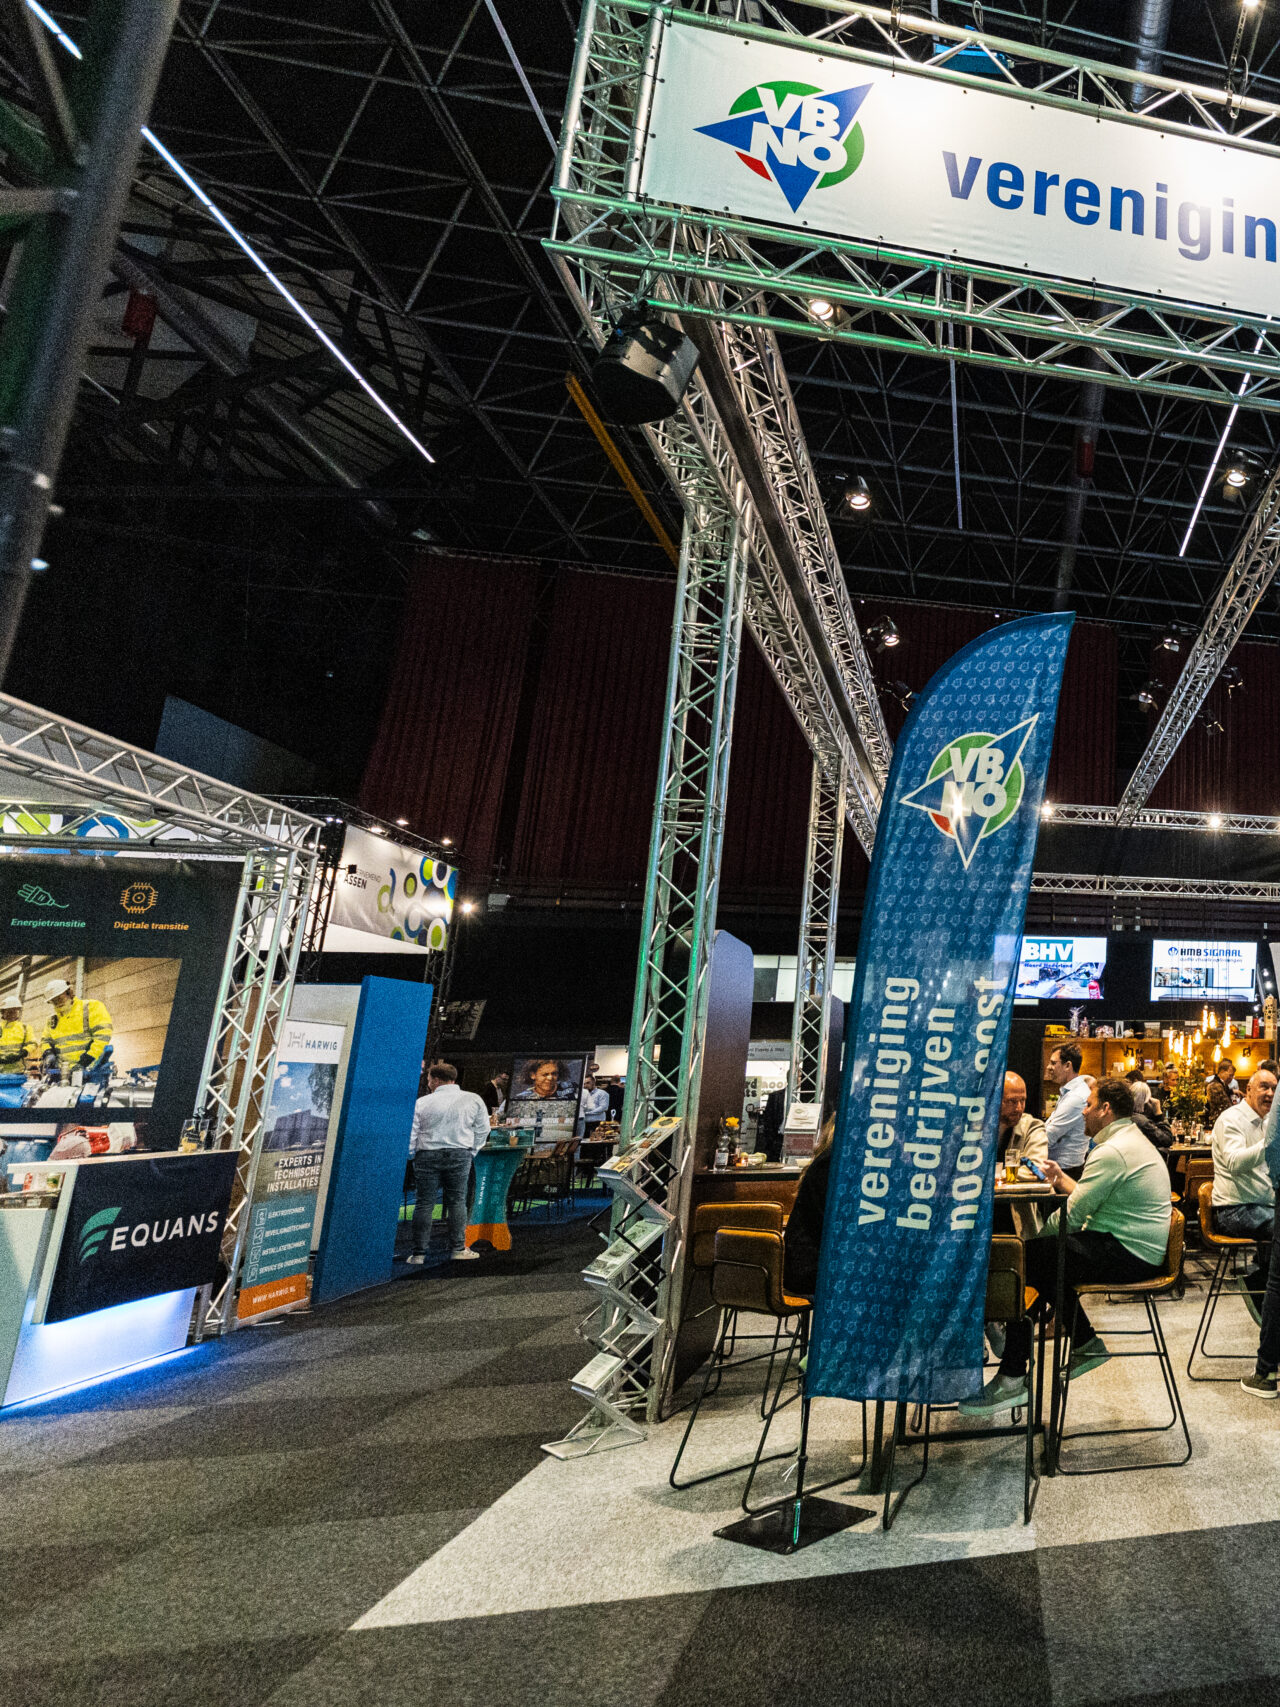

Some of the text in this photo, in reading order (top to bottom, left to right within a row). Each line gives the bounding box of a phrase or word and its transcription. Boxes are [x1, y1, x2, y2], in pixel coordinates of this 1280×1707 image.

[755, 86, 841, 138] VB
[749, 121, 848, 173] NO
[949, 747, 1005, 783] VB
[343, 874, 368, 890] ASSEN
[10, 918, 86, 929] Energietransitie
[113, 921, 189, 932] Digitale transitie
[1022, 942, 1073, 961] BHV
[1180, 948, 1202, 957] HMB
[305, 1039, 338, 1051] HARWIG
[857, 976, 921, 1226] vereniging
[895, 1007, 957, 1231] bedrijven
[277, 1154, 322, 1168] EXPERTS IN
[274, 1165, 321, 1180] TECHNISCHE
[266, 1177, 319, 1193] INSTALLATIES
[110, 1210, 219, 1252] EQUANS
